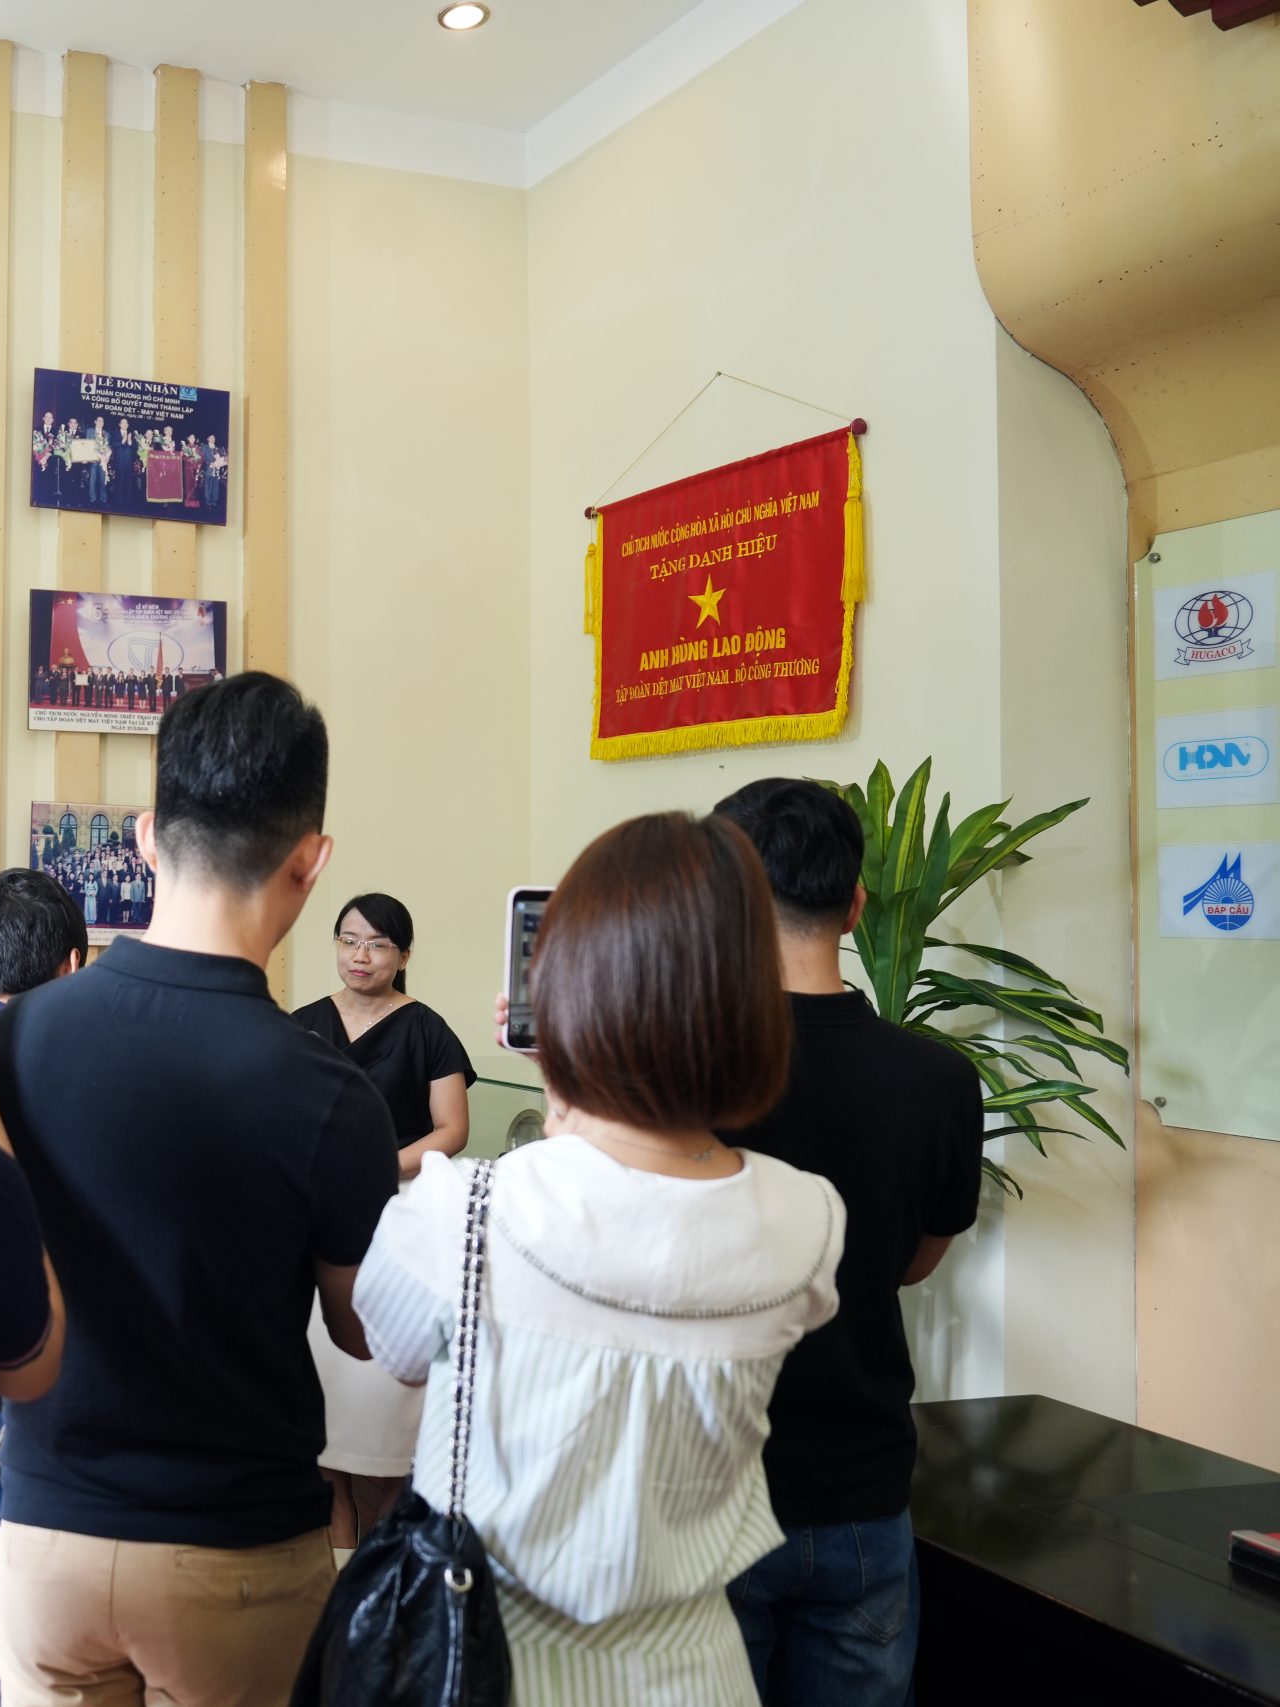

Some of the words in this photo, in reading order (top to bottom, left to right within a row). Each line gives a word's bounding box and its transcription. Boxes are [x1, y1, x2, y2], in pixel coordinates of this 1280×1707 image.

[144, 383, 178, 395] NHẬN
[621, 534, 634, 557] CHỦ
[635, 535, 650, 557] TỊCH
[650, 525, 670, 549] NƯỚC
[671, 522, 690, 547] CỘNG
[690, 515, 707, 537] HÒA
[708, 511, 719, 534] XÃ
[720, 507, 734, 533] HỘI
[735, 499, 752, 525] CHỦ
[753, 496, 778, 521] NGHĨA
[780, 491, 798, 518] VIỆT
[799, 490, 820, 510] NAM
[649, 556, 686, 582] TẶNG
[688, 545, 733, 569] DANH
[736, 532, 778, 559] HIỆU
[639, 648, 669, 672] ANH
[671, 636, 708, 666] HÙNG
[712, 634, 741, 658] LAO
[744, 625, 786, 657] ĐỘNG
[1190, 645, 1236, 660] HUGACO
[615, 684, 629, 706] TẬP
[629, 679, 651, 700] ĐOÀN
[652, 676, 668, 700] DỆT
[669, 676, 684, 694] MAY
[685, 668, 706, 692] VIỆT
[735, 662, 747, 687] BỘ
[748, 659, 772, 681] CÔNG
[773, 657, 820, 678] THƯƠNG
[1207, 905, 1226, 914] ĐÁP
